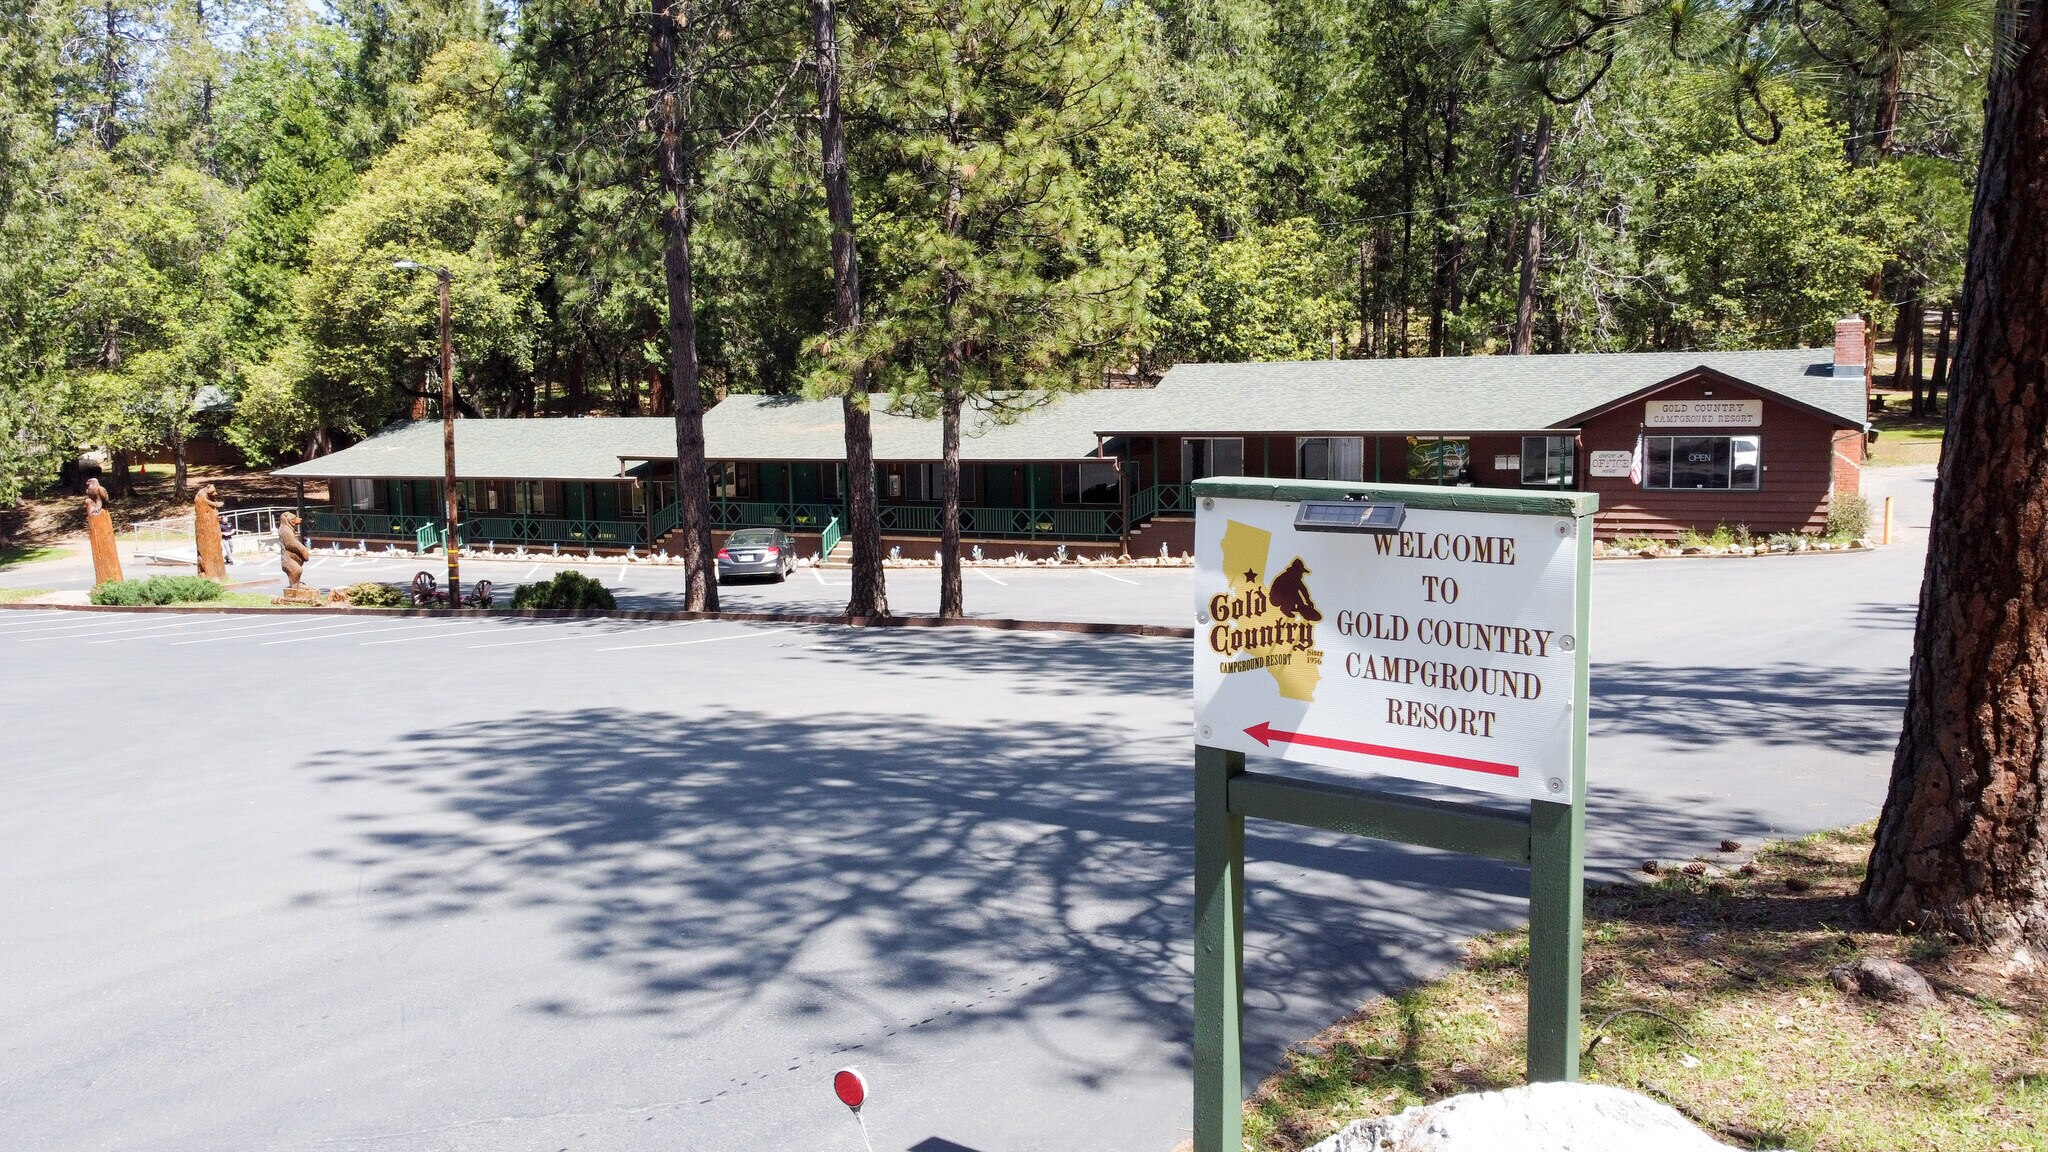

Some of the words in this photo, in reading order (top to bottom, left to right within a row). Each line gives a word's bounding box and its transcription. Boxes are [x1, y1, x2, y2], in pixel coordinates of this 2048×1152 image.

[1653, 415, 1714, 423] CAMPGROUND
[1718, 414, 1753, 423] RESORT
[1662, 404, 1688, 412] GOLD
[1694, 403, 1744, 412] COUNTRY
[1592, 459, 1629, 468] OFFICE
[1688, 453, 1711, 461] OPEN
[1373, 531, 1515, 565] WELCOME
[1210, 586, 1267, 621] Gold
[1422, 575, 1459, 604] TO
[1210, 617, 1314, 656] Country
[1337, 610, 1409, 641] GOLD
[1417, 617, 1554, 657] COUNTRY
[1219, 656, 1265, 674] CAMPGROUND
[1265, 653, 1292, 668] RESORT
[1306, 648, 1324, 657] Since
[1346, 652, 1541, 700] CAMPGROUND
[1385, 698, 1496, 738] RESORT
